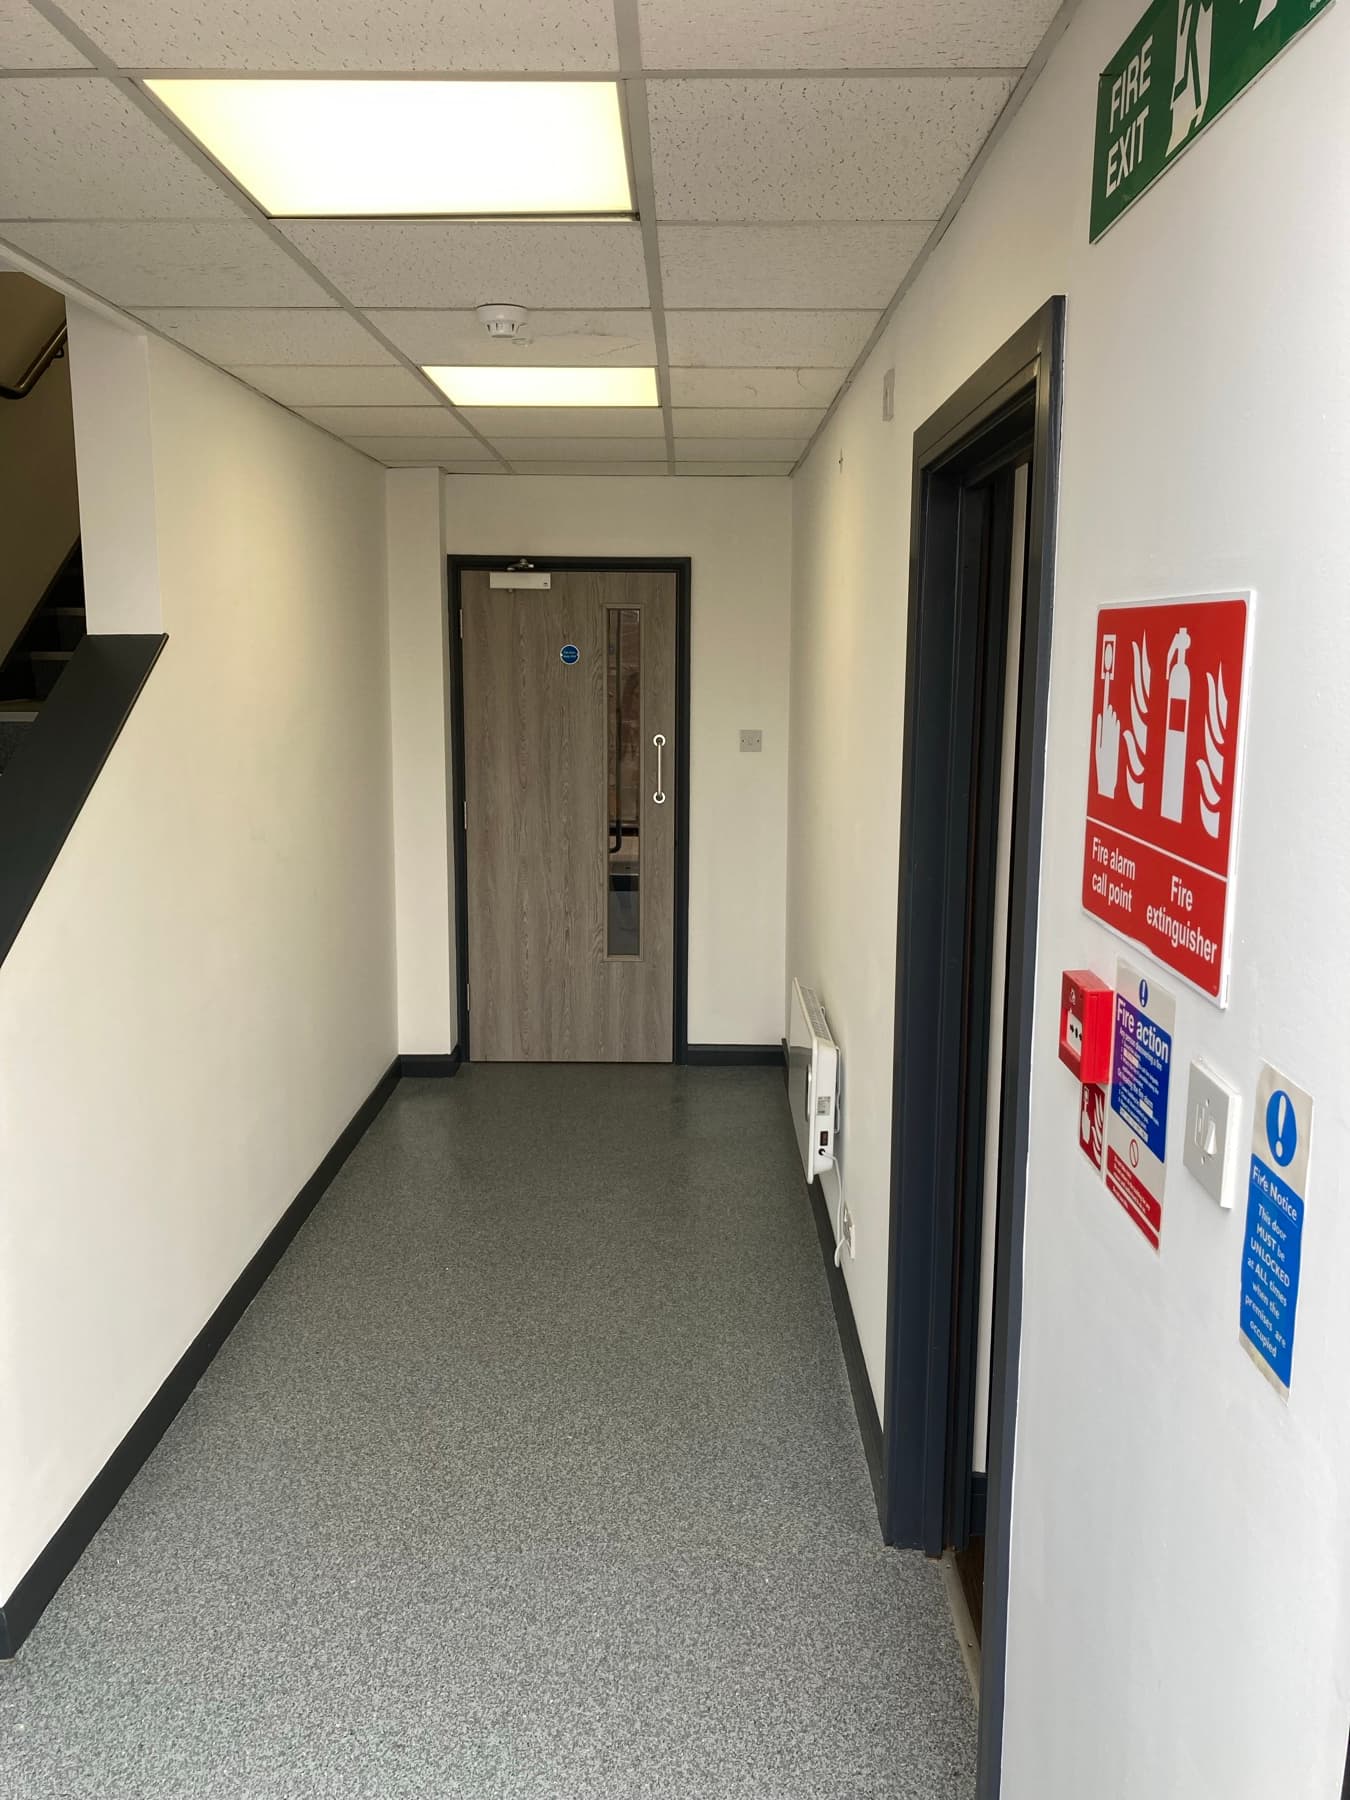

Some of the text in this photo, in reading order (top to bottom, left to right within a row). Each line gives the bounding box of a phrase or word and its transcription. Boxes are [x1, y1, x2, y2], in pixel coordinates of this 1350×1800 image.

[1109, 34, 1153, 133] FIRE
[1105, 105, 1149, 199] EXIT
[1092, 836, 1136, 880] Fire alarm
[1092, 872, 1132, 912] call point
[1171, 875, 1193, 911] Fire
[1146, 904, 1217, 964] extinguisher
[1117, 999, 1135, 1034] Fire
[1136, 1020, 1169, 1064] action
[1252, 1165, 1298, 1222] Fire Notice
[1256, 1223, 1286, 1263] MUST be
[1257, 1203, 1287, 1241] This door
[1247, 1257, 1287, 1307] at ALL times
[1250, 1236, 1290, 1288] UNLOCKED
[1244, 1294, 1287, 1349] premises are
[1252, 1280, 1280, 1320] when the
[1249, 1320, 1278, 1358] occupied
